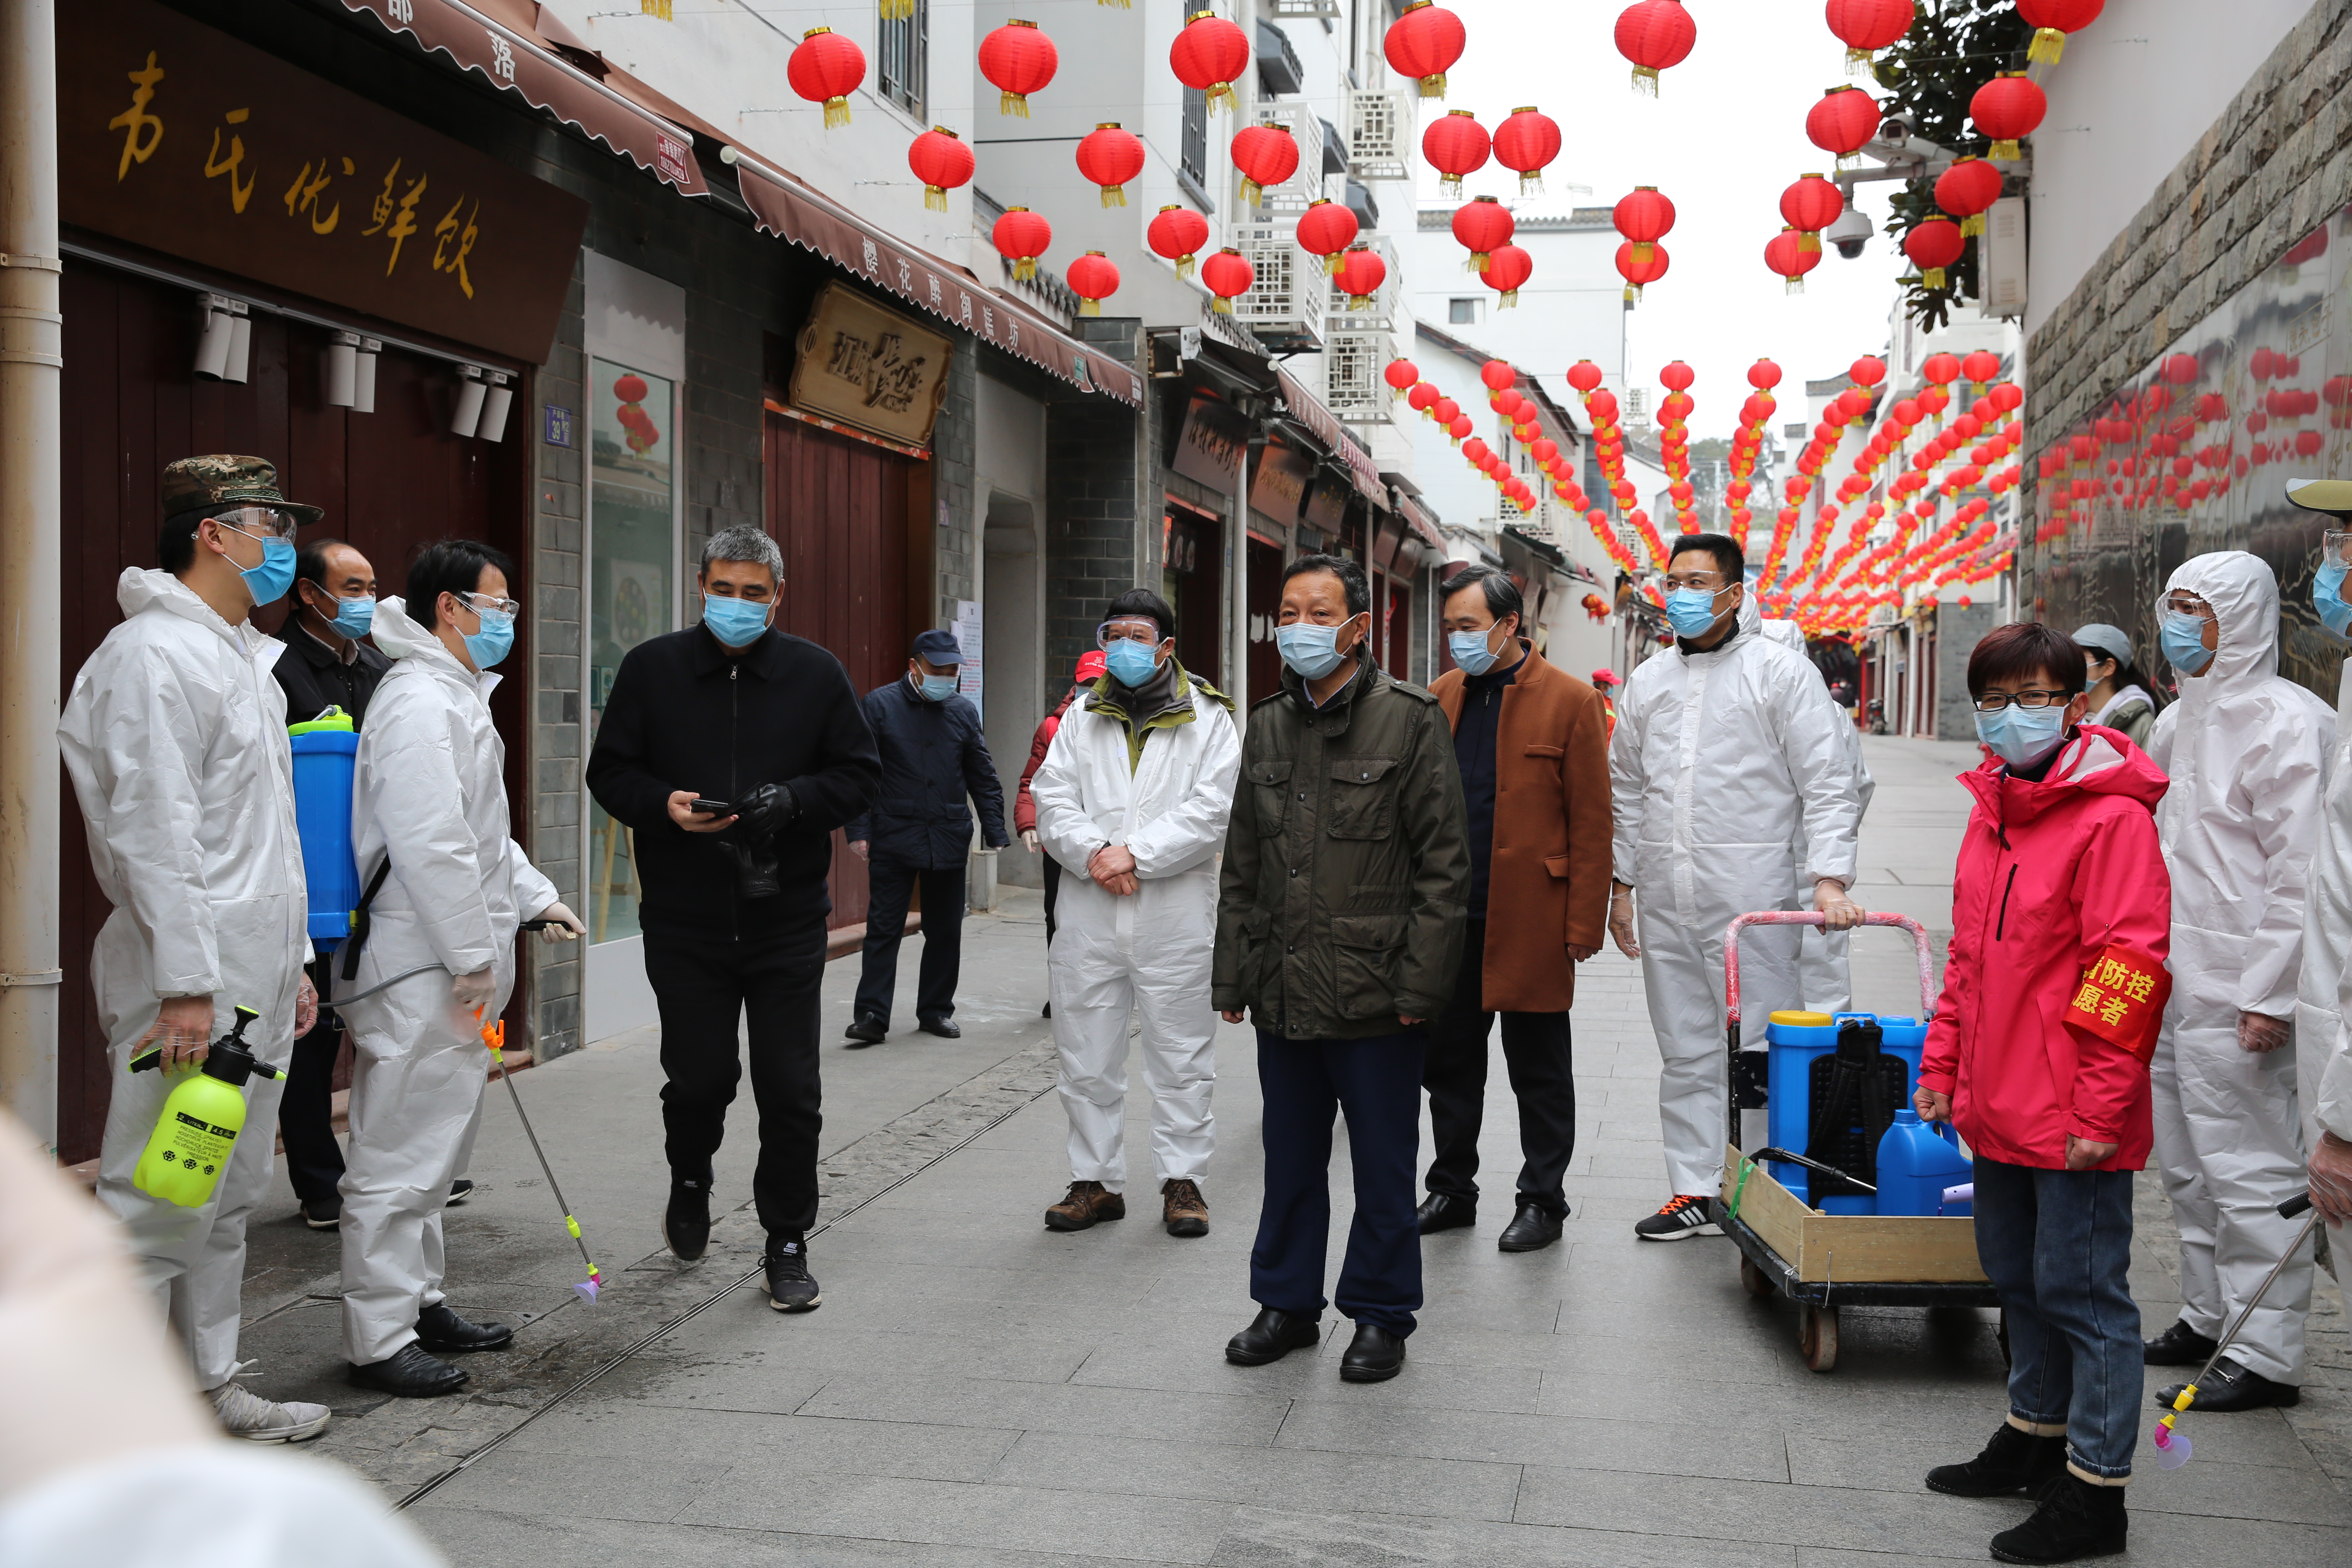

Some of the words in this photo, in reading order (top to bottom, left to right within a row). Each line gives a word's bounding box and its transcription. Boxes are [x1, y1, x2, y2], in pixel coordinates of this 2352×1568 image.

[552, 420, 561, 440] 39
[2071, 983, 2129, 1027] 愿者
[180, 1125, 203, 1137] PRESSURE
